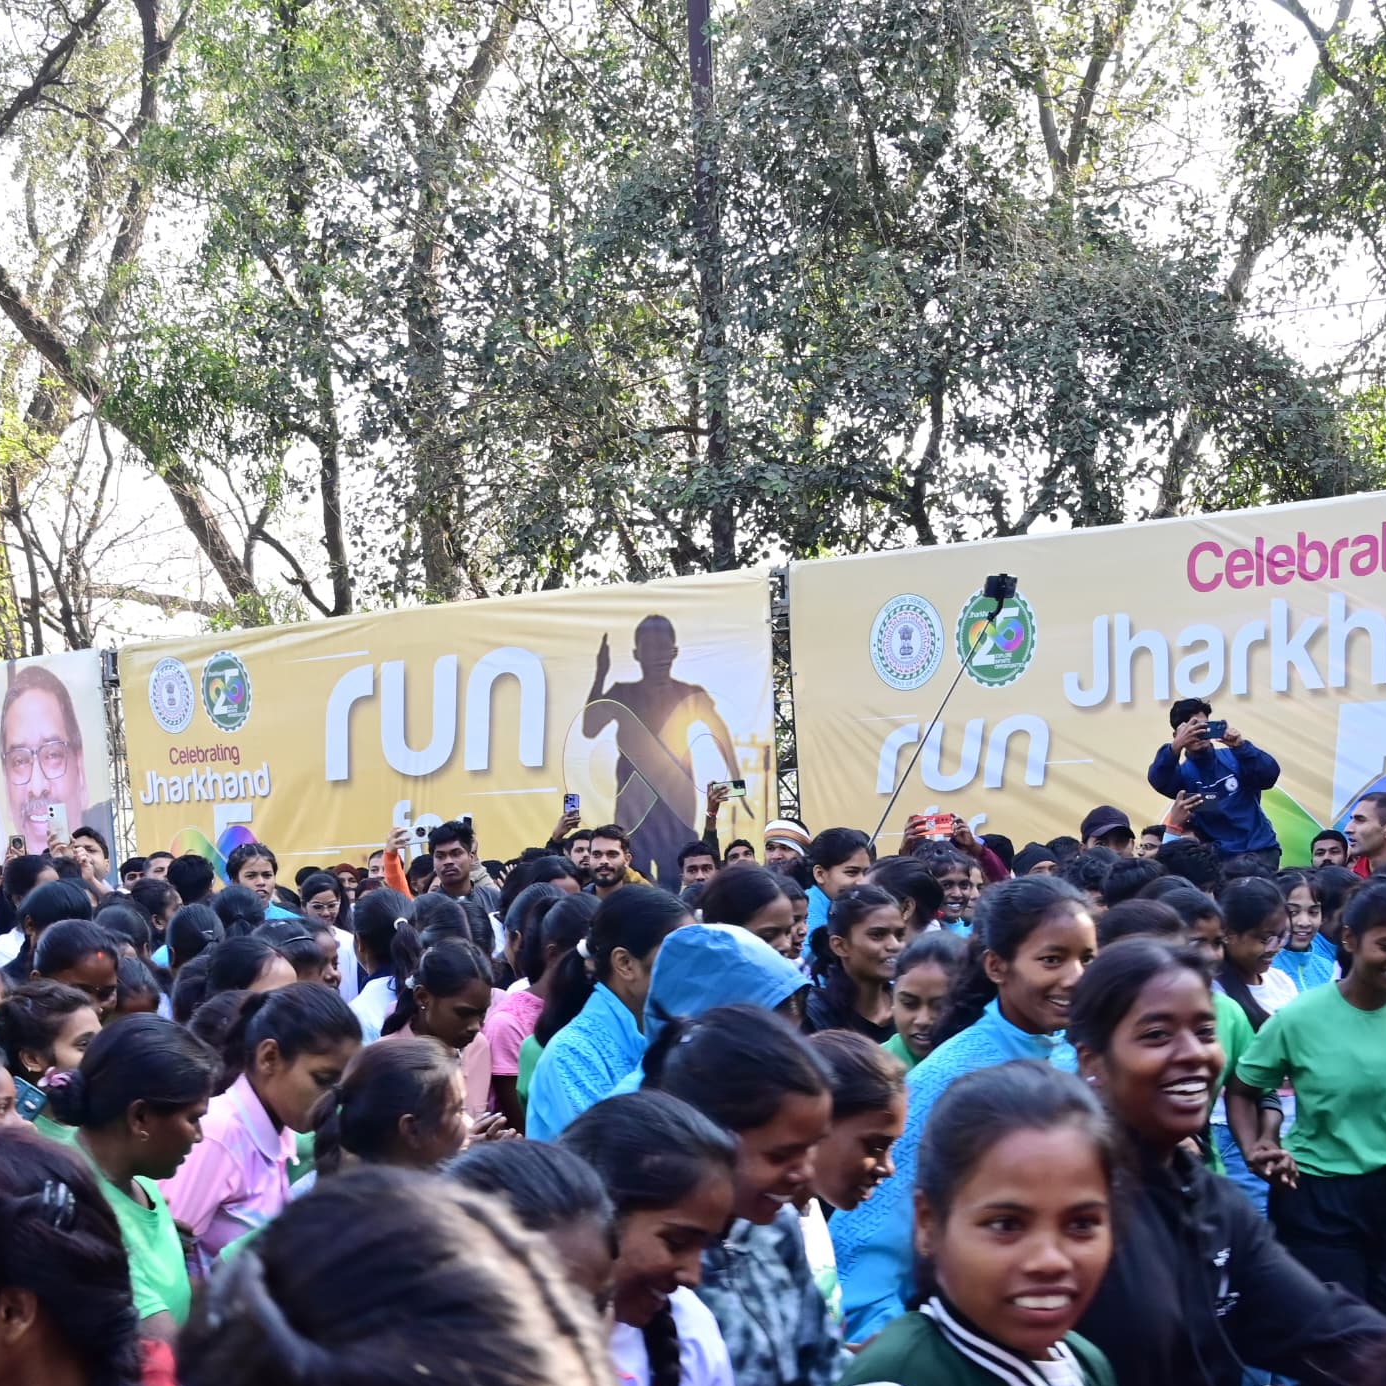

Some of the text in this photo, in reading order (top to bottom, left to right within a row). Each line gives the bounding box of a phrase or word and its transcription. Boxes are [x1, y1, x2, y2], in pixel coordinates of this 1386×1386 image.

[325, 645, 547, 782] run
[139, 760, 271, 807] Jharkhand
[169, 743, 241, 766] Celebrating
[876, 713, 1050, 795] run
